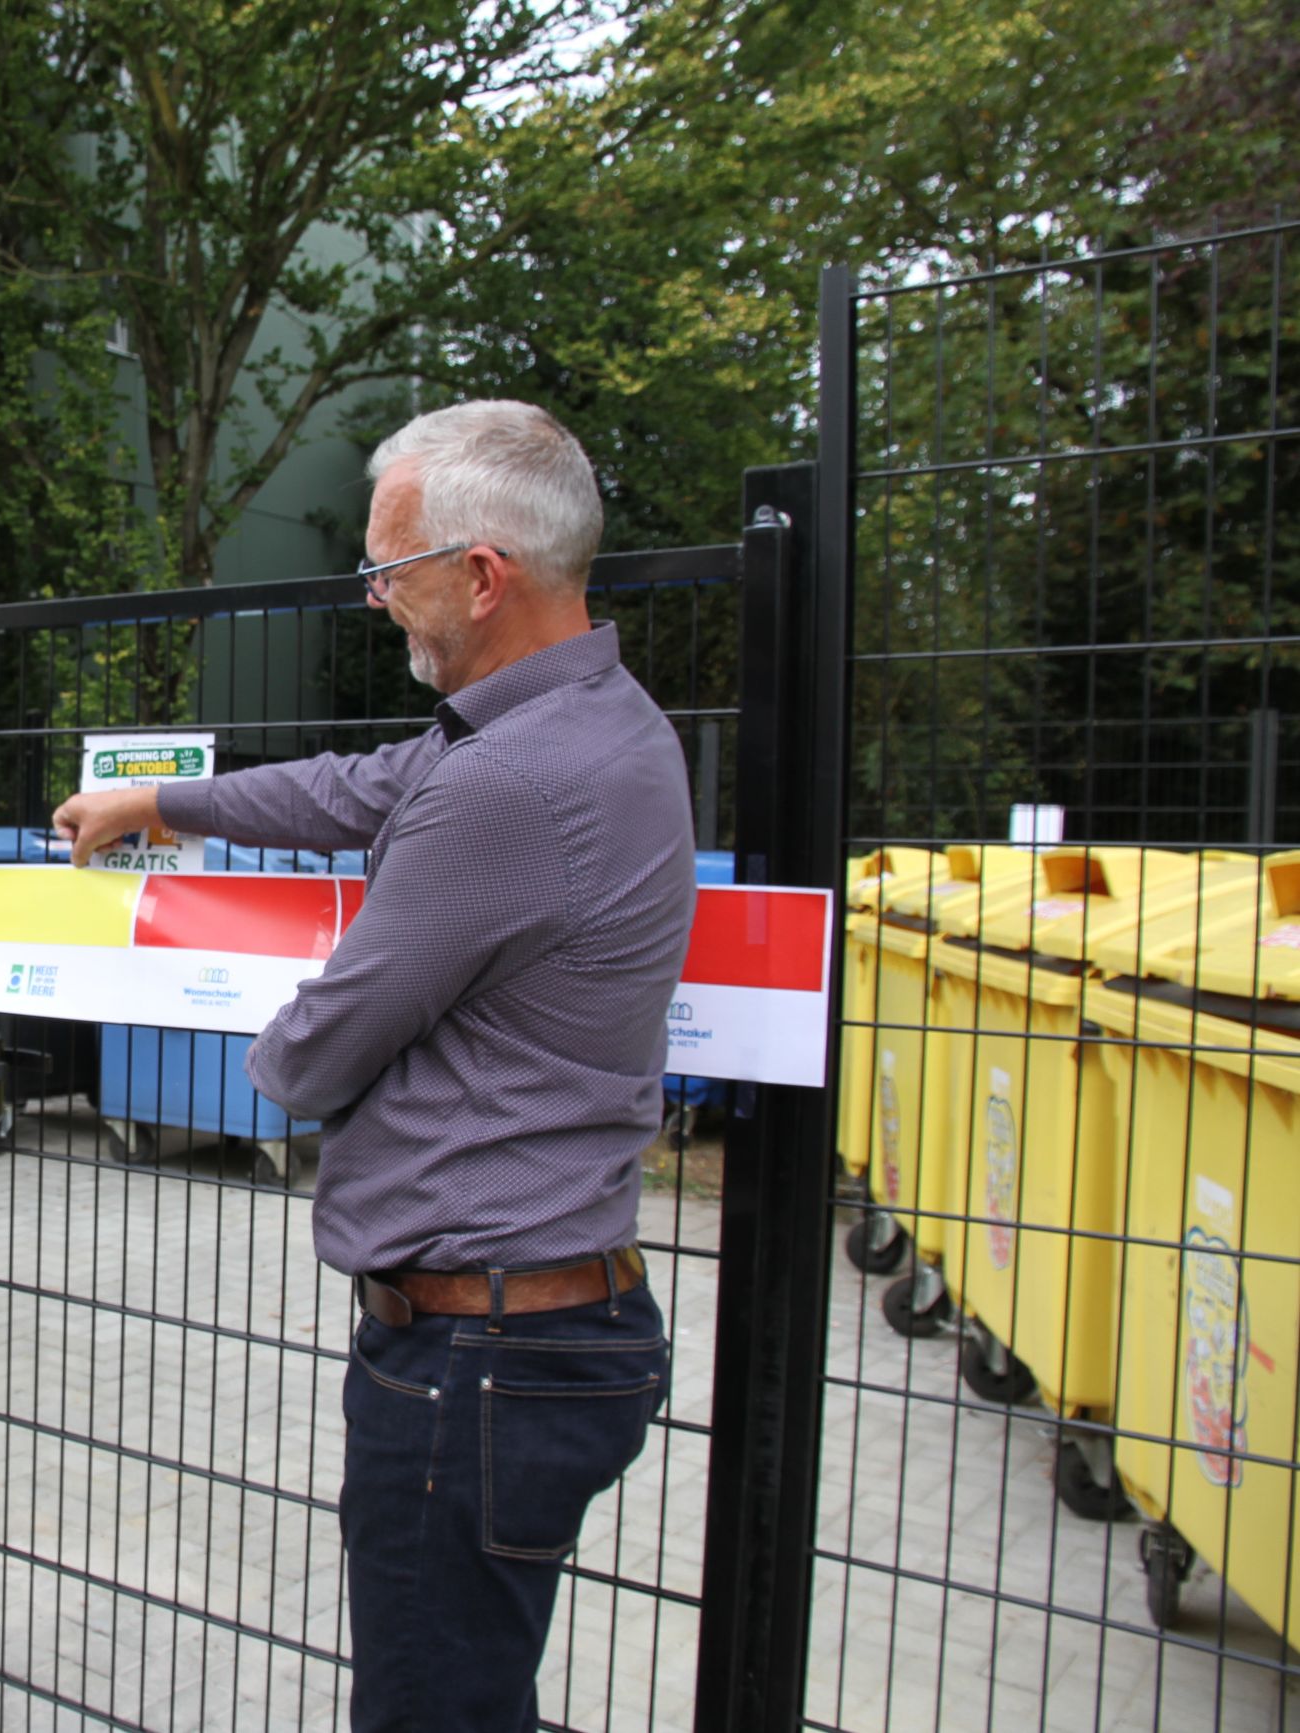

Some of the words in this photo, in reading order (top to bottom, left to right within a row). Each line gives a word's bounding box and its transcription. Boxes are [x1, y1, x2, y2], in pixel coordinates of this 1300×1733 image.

[116, 751, 159, 762] OPENING
[160, 750, 175, 760] OP
[116, 763, 124, 775] 7
[125, 761, 177, 775] OKTOBER
[104, 852, 178, 871] GRATIS
[35, 965, 58, 976] HEIST
[31, 985, 55, 997] BERG
[668, 1027, 712, 1039] schakel
